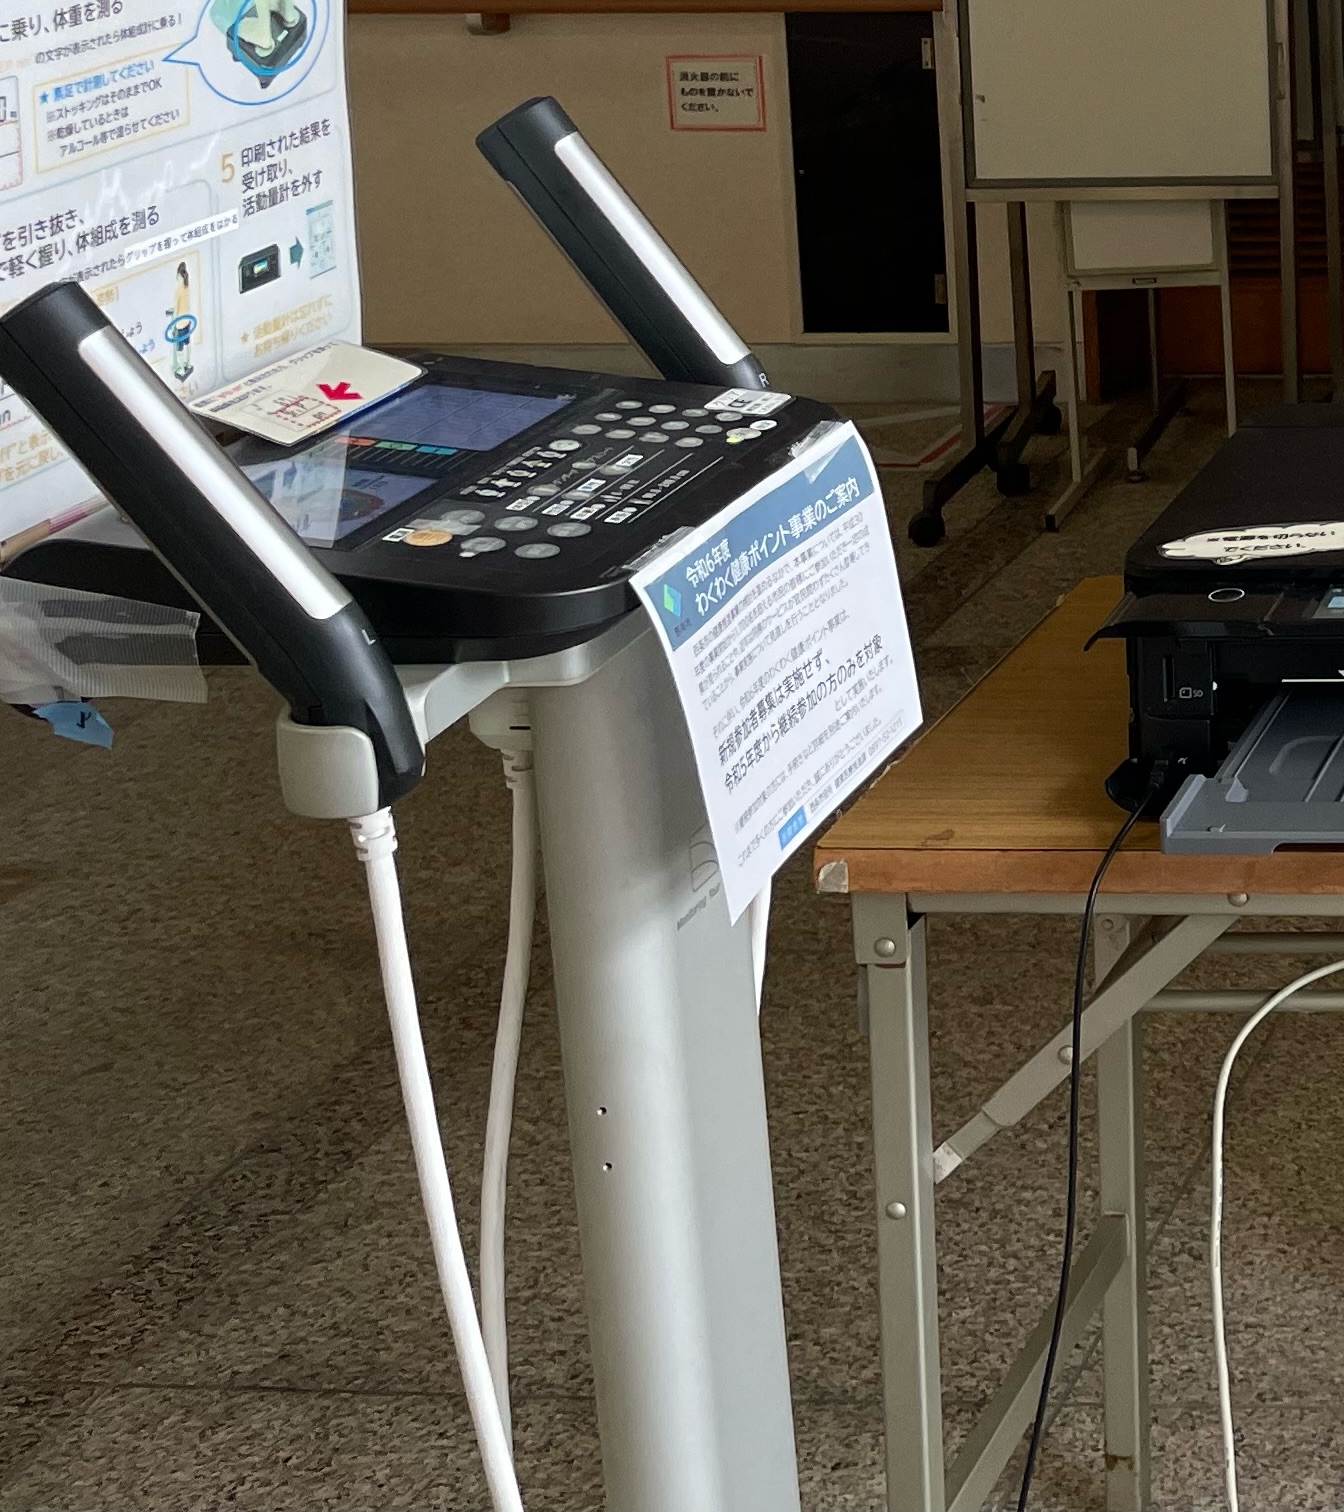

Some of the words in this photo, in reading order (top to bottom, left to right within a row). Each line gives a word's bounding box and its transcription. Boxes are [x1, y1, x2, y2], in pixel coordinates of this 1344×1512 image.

[220, 152, 235, 184] 5
[686, 537, 732, 588] 令和6年度
